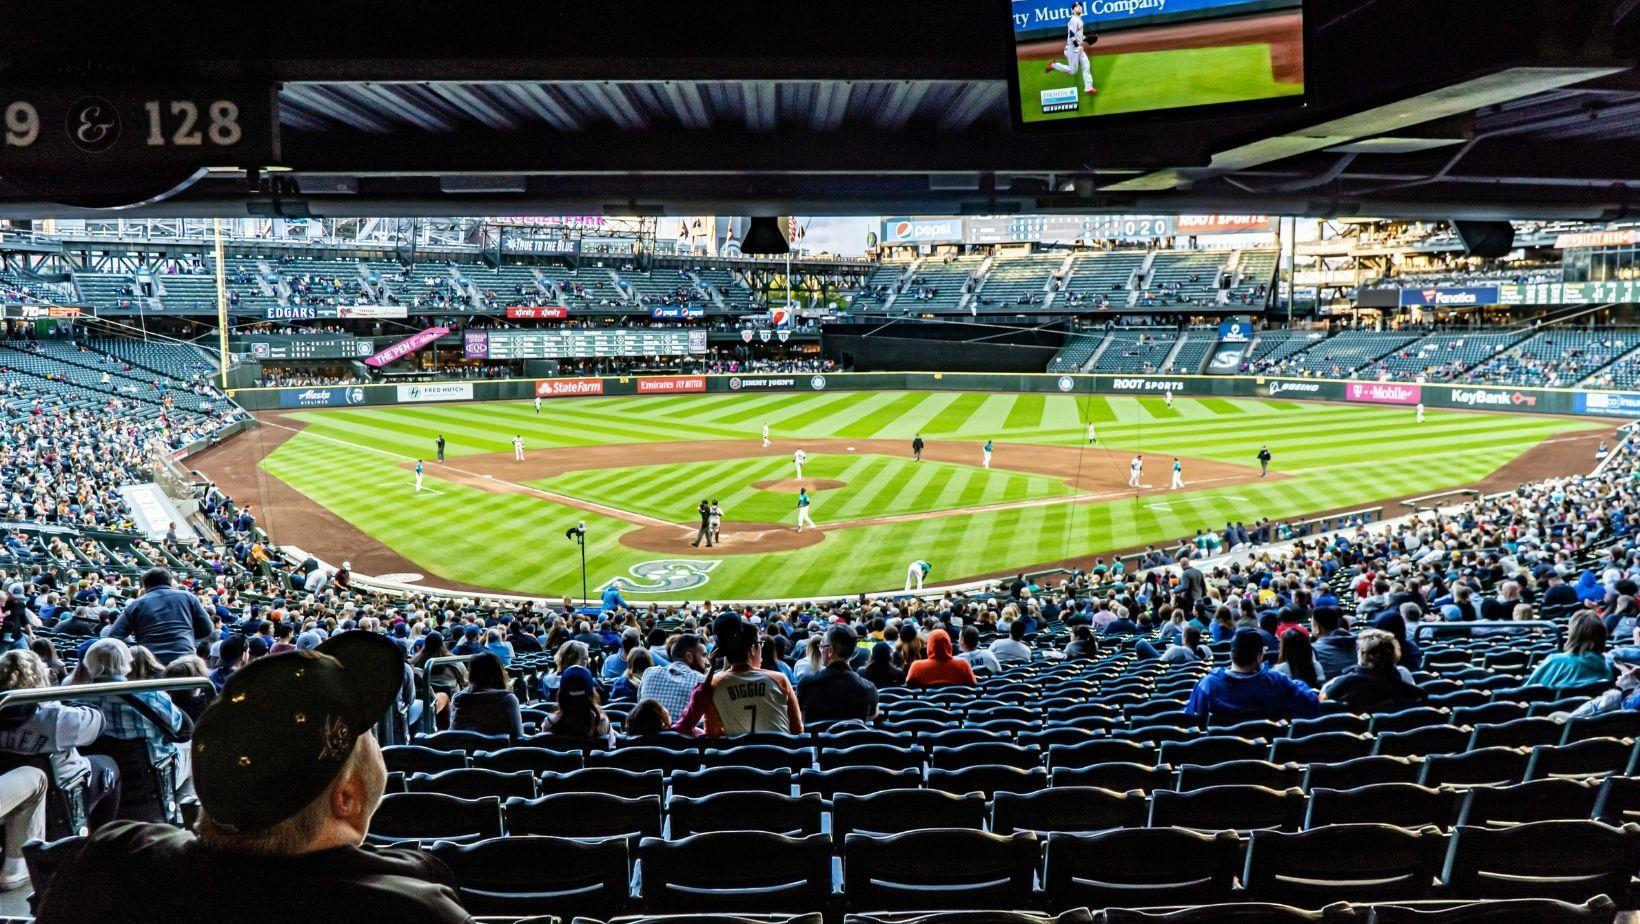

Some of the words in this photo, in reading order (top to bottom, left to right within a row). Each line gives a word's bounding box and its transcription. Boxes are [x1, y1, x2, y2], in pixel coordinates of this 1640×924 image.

[1035, 6, 1088, 22] Mutul
[1092, 0, 1166, 14] Company
[5, 101, 40, 146] 9
[77, 106, 115, 143] &
[144, 101, 242, 146] 128
[914, 224, 952, 237] pepsi
[516, 240, 533, 251] TRUE
[534, 240, 544, 251] TO
[544, 240, 556, 251] THE
[557, 240, 575, 252] BLUE
[1436, 292, 1476, 304] Fanatics
[375, 350, 394, 365] THE
[641, 381, 674, 390] Emirates
[1113, 379, 1145, 389] ROOT
[1145, 382, 1184, 390] SPORTS
[1281, 383, 1320, 392] BOEING
[299, 390, 330, 400] Alaska
[1452, 389, 1510, 405] KeyBank
[727, 682, 766, 701] BIGGIO
[744, 704, 757, 734] 7
